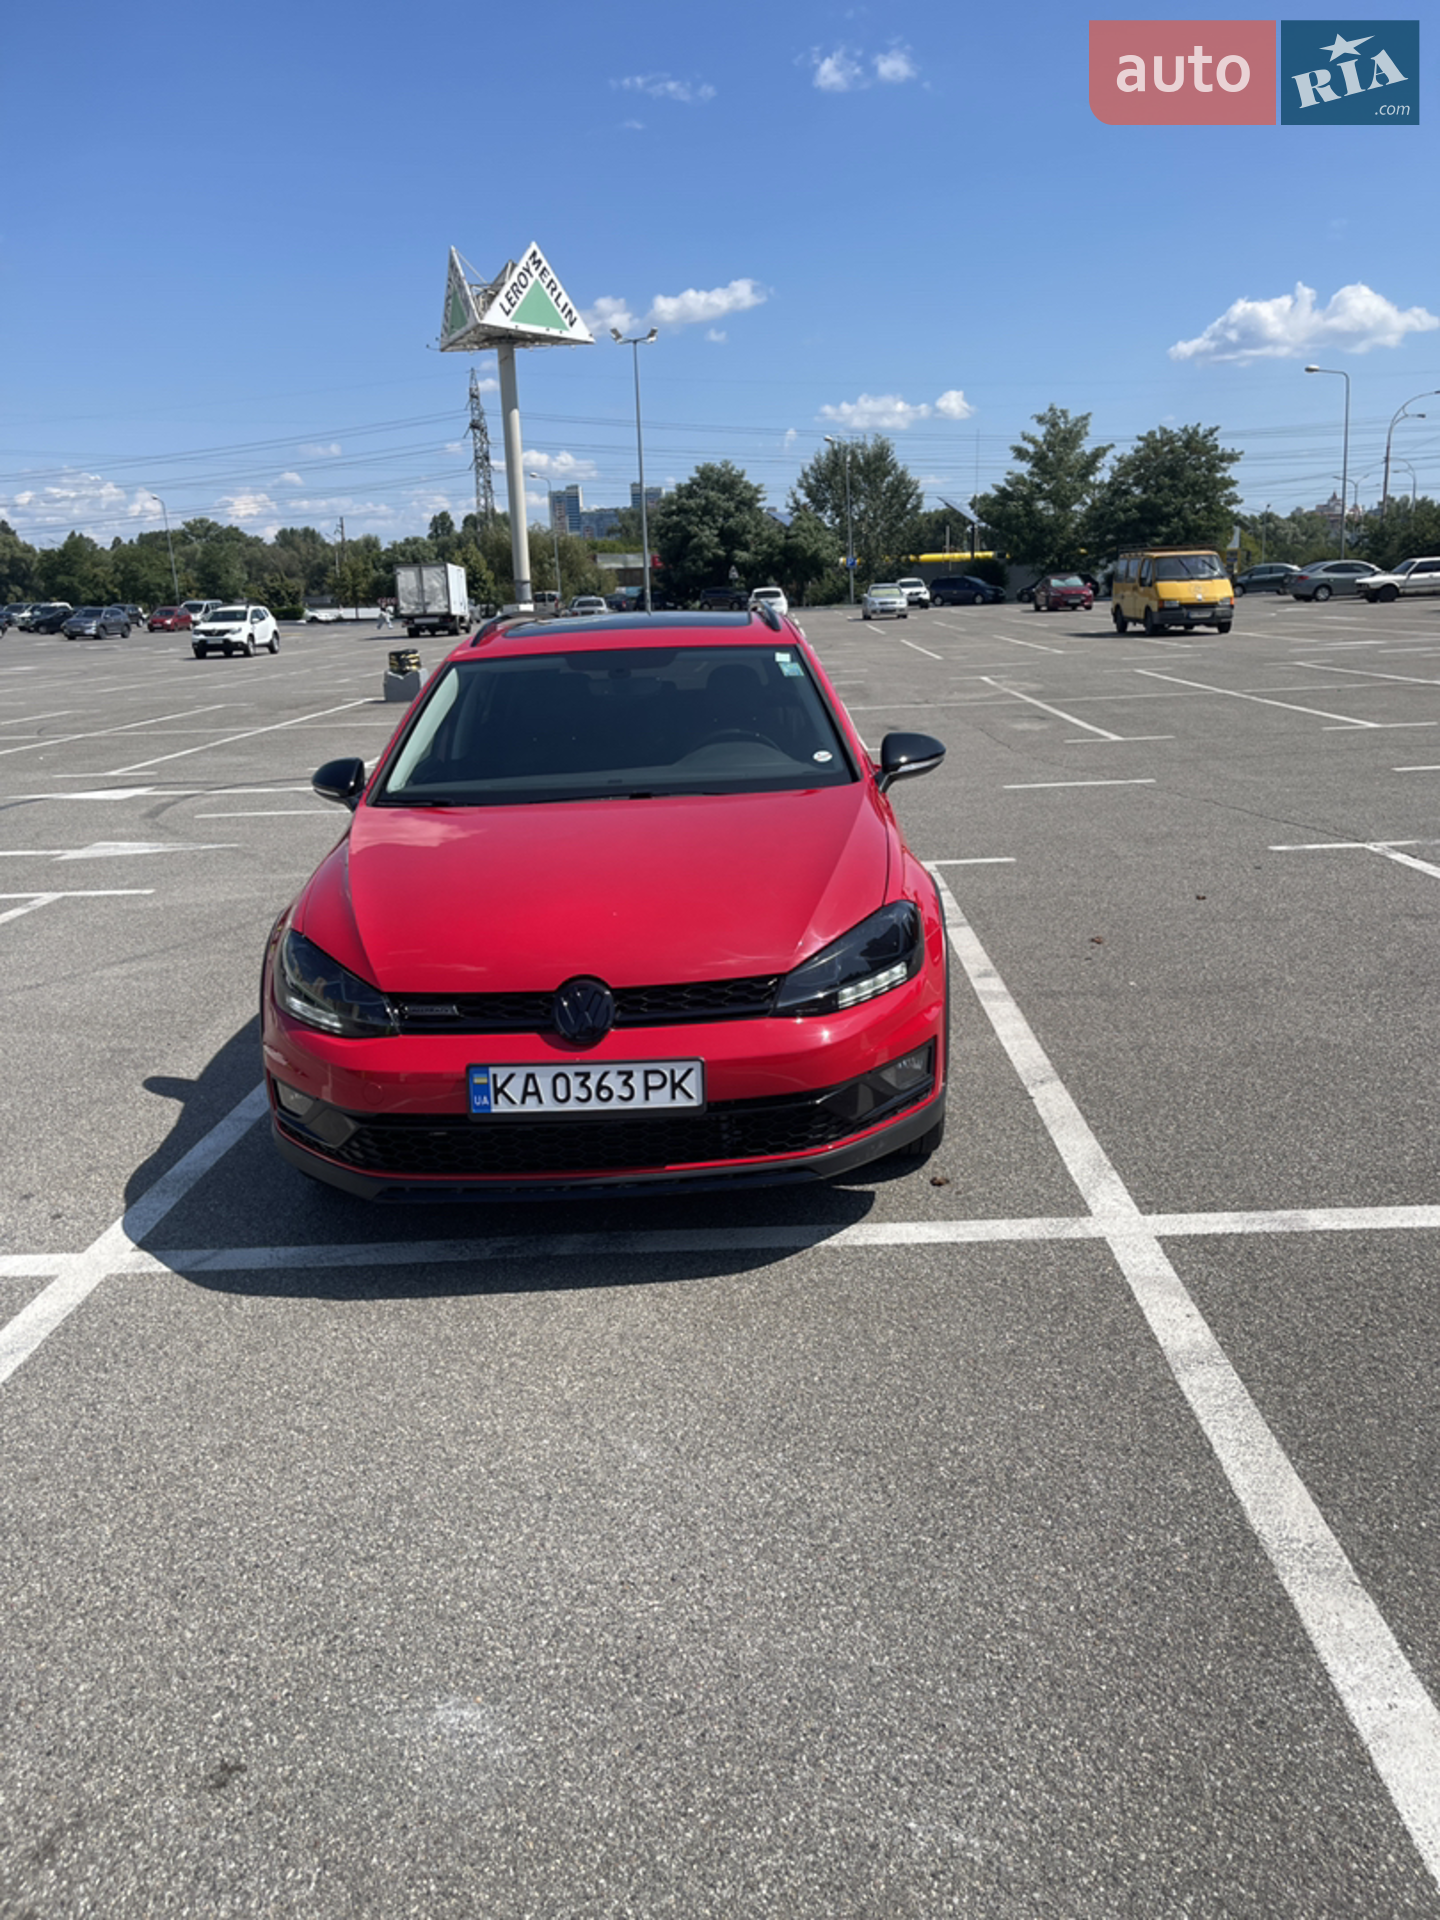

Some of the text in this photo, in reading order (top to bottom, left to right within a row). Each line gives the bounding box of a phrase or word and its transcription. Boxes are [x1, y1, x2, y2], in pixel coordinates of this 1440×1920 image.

[499, 261, 534, 317] LEROY
[529, 250, 578, 328] MERLIN
[474, 1095, 489, 1107] UA
